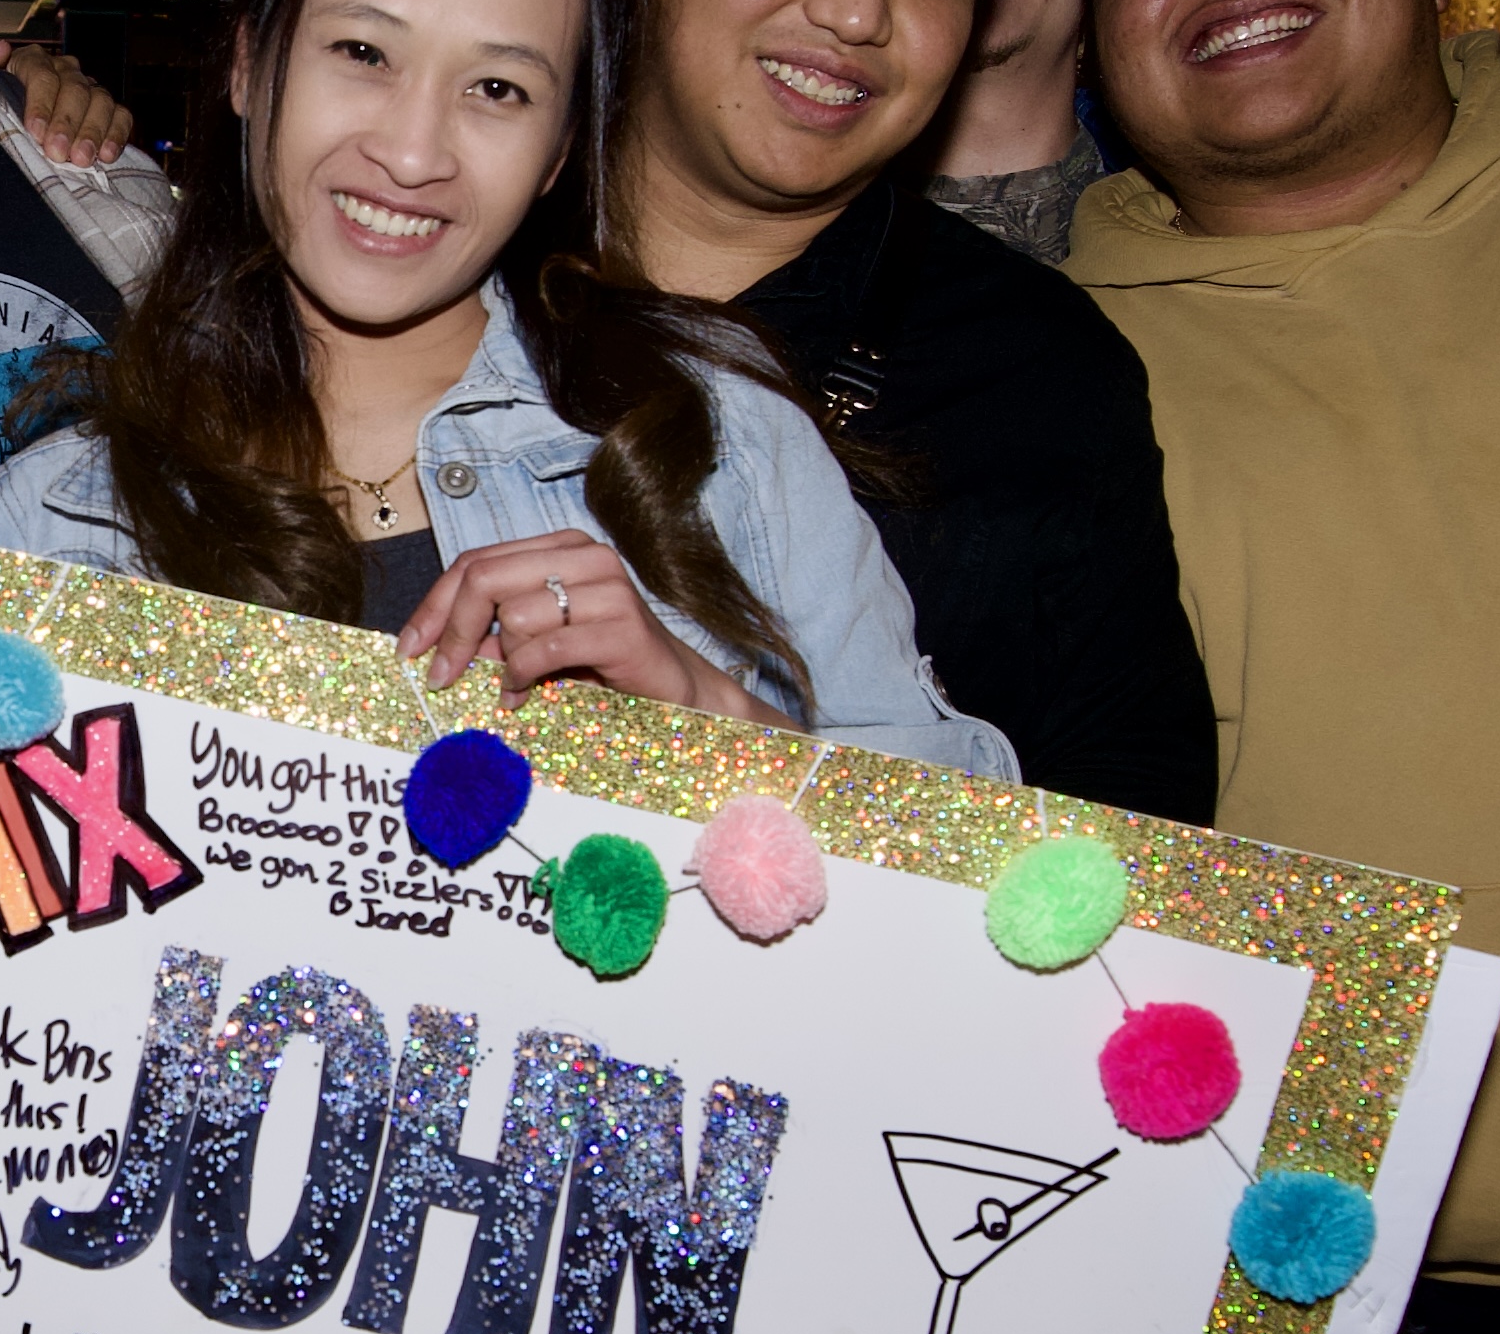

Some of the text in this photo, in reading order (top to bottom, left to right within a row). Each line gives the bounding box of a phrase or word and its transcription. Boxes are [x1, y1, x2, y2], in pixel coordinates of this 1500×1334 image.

[191, 721, 408, 814] You got this
[261, 857, 319, 889] gon
[327, 861, 347, 886] 2
[356, 898, 454, 937] Jared
